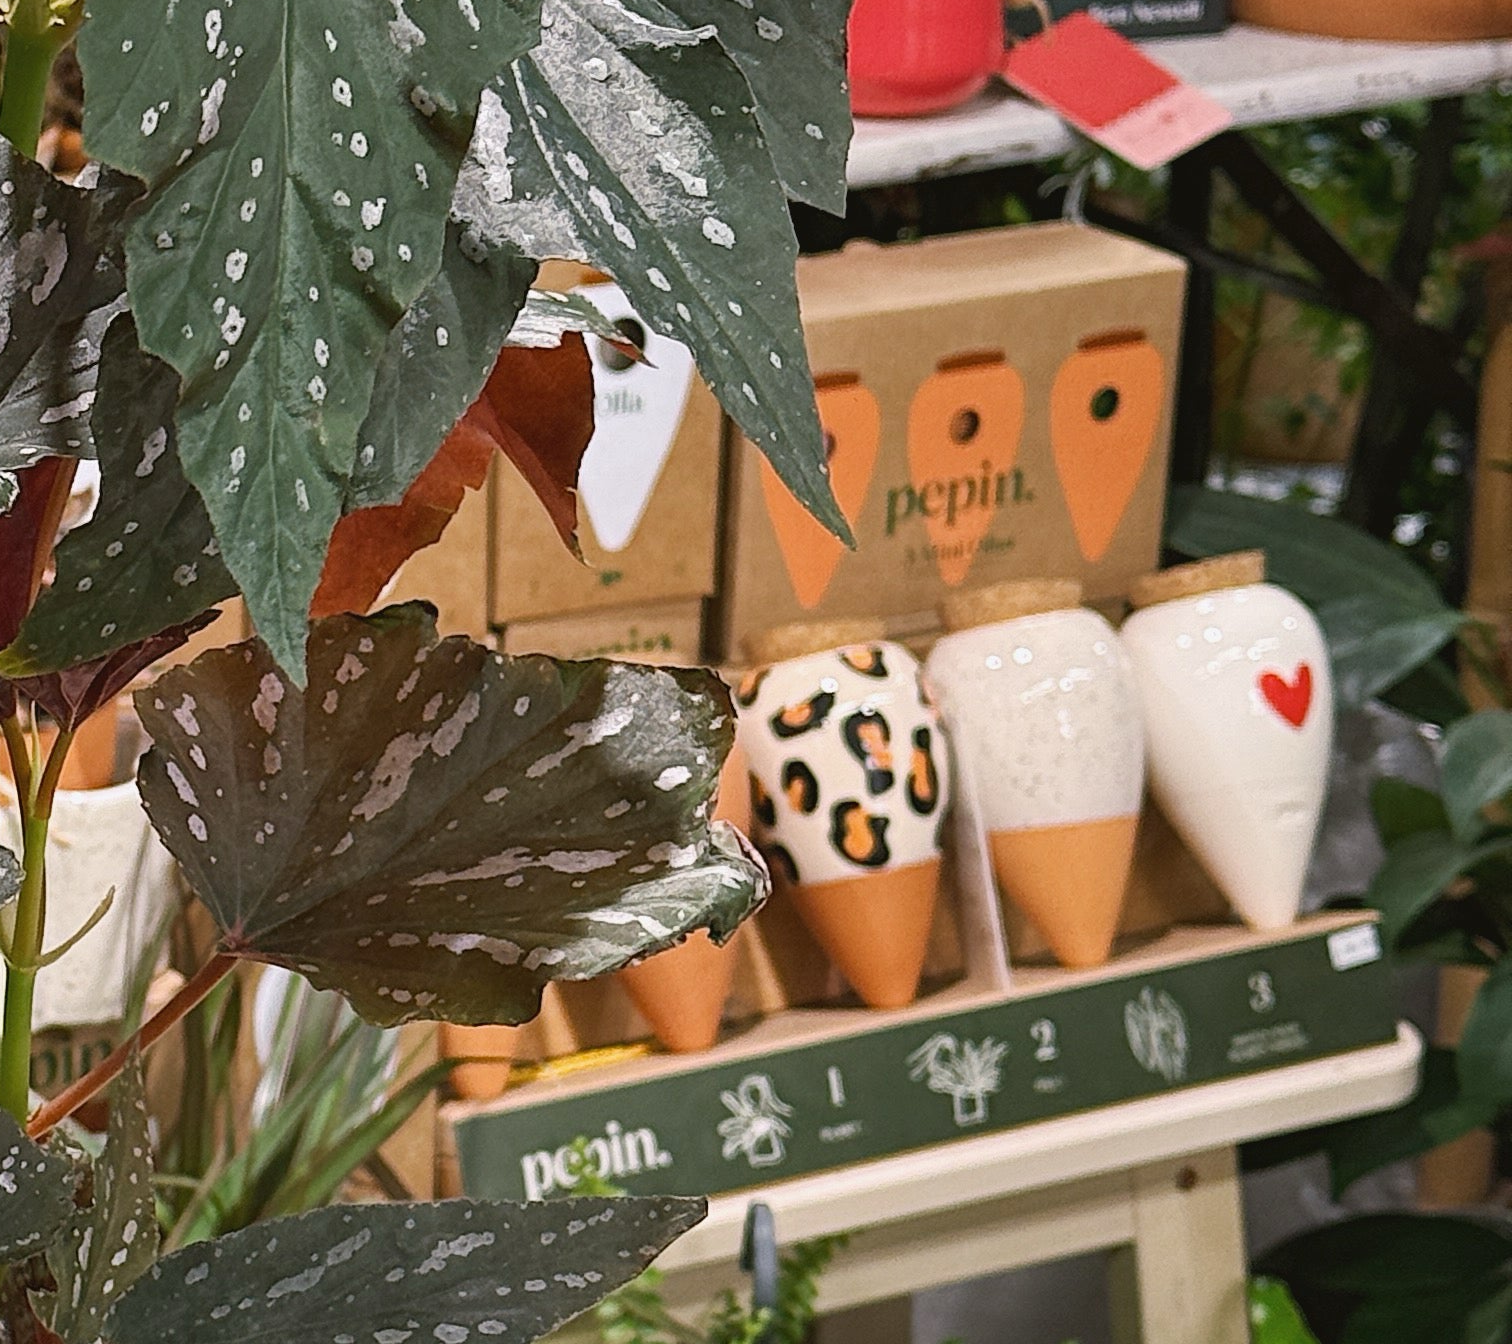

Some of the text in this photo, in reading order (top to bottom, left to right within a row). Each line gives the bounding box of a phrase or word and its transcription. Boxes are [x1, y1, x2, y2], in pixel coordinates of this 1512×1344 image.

[885, 459, 1034, 537] pepin.
[1248, 971, 1276, 1013] 3
[1030, 1018, 1058, 1062] 2
[827, 1065, 846, 1108] 1
